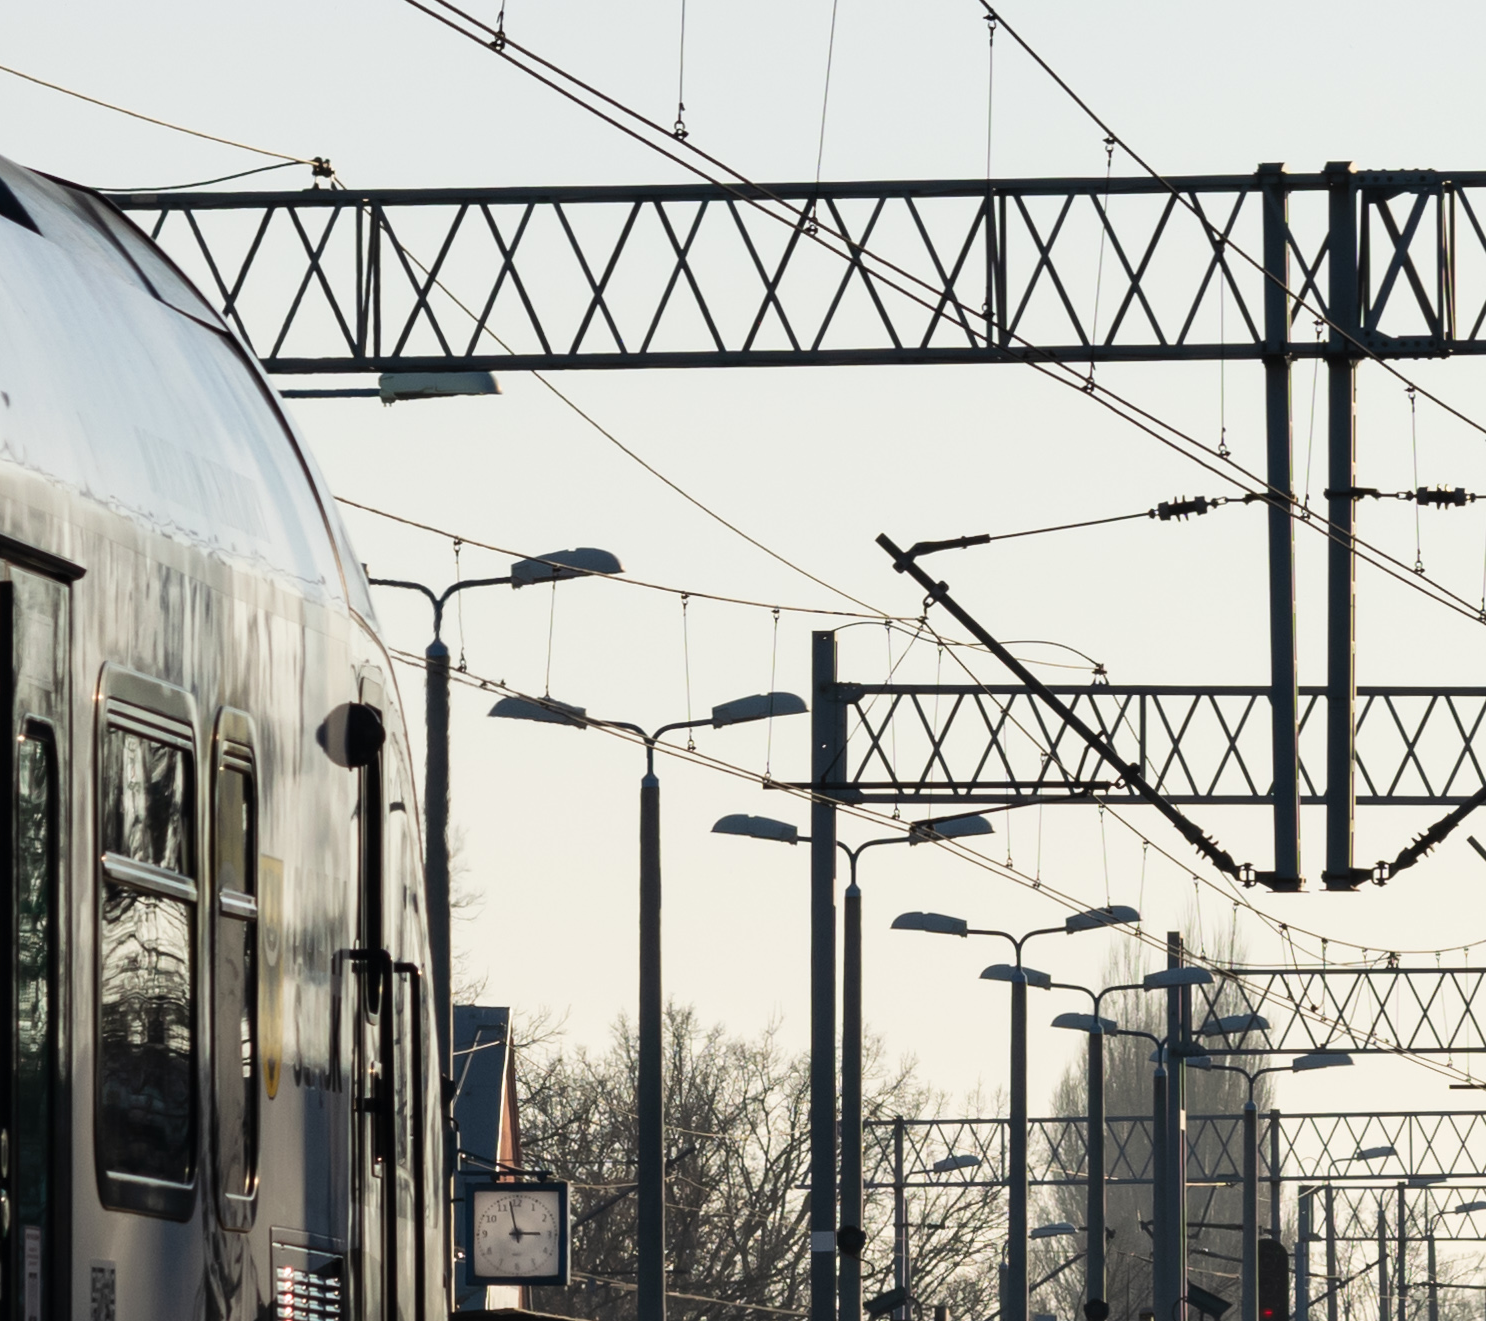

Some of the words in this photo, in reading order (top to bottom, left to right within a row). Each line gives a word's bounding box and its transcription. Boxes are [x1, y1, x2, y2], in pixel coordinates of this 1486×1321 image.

[513, 1199, 522, 1207] 12
[497, 1204, 507, 1212] 11
[486, 1215, 497, 1223] 10
